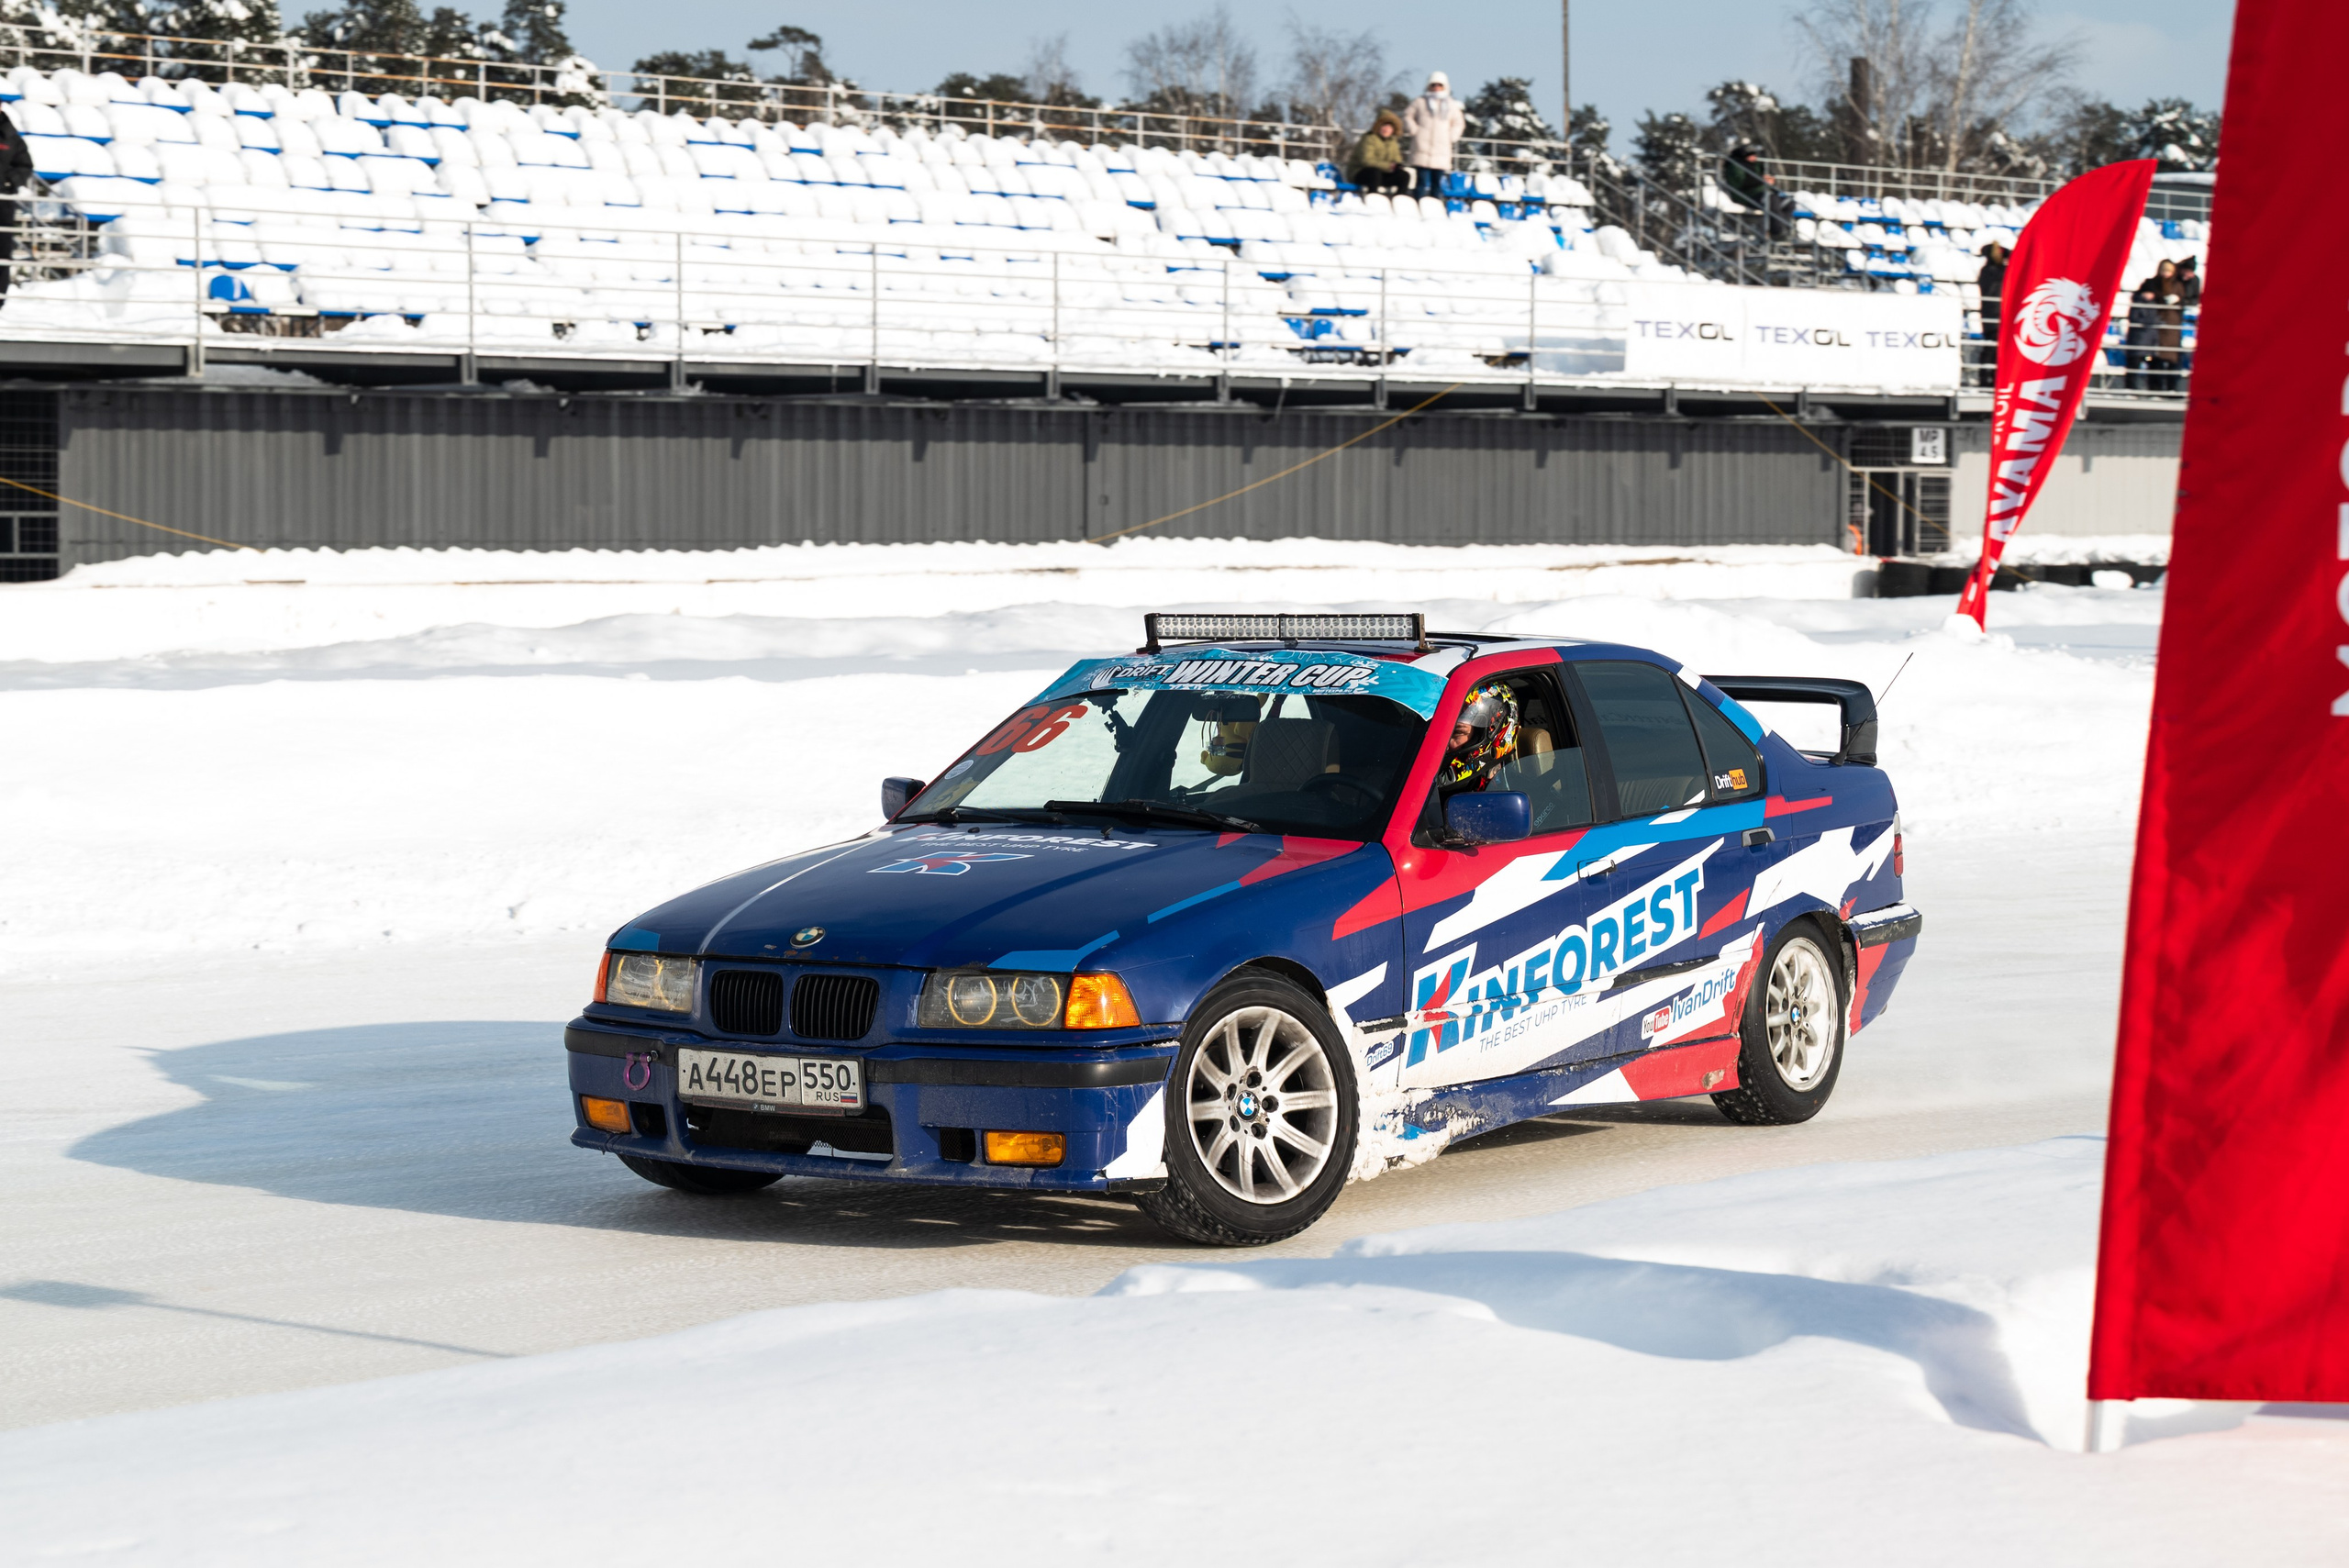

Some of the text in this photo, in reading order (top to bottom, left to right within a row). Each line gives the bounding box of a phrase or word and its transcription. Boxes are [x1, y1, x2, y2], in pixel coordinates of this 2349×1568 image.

[1634, 320, 1733, 340] TEXOL
[1755, 326, 1851, 347] TEXOL
[1865, 331, 1956, 349] TEXOL
[1114, 663, 1175, 679] DRIFT
[1162, 660, 1375, 687] WINTER CUP
[975, 705, 1088, 756] 66
[895, 831, 1158, 850] KINFOREST
[1041, 844, 1090, 853] TYRE
[1406, 867, 1699, 1069] KINFOREST
[1673, 968, 1736, 1024] IvanDrift
[1480, 994, 1587, 1053] THE BEST UHP TYRE
[803, 1062, 852, 1091] 550
[816, 1091, 841, 1103] RUS
[760, 1104, 776, 1112] BMW
